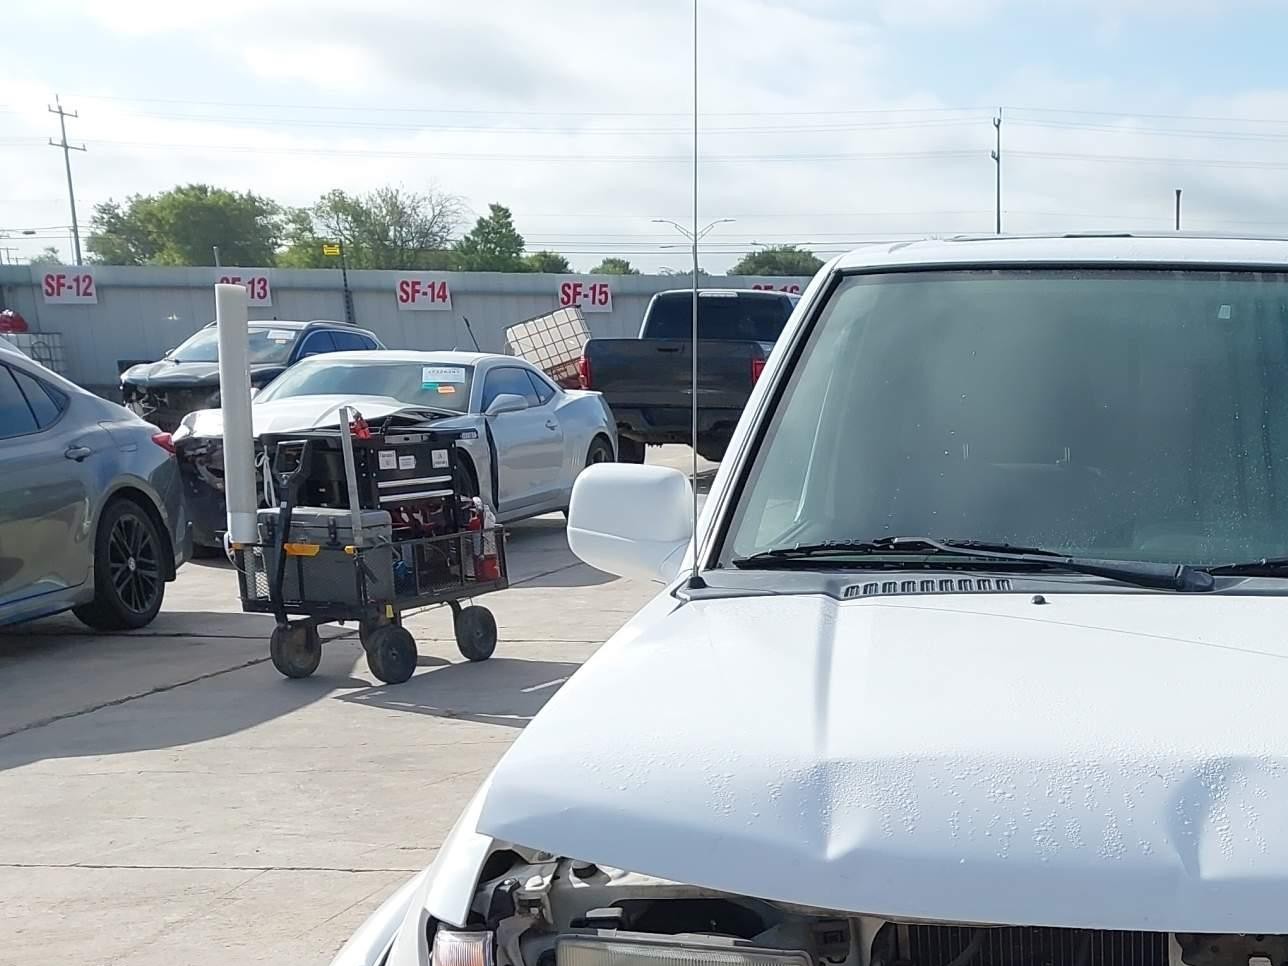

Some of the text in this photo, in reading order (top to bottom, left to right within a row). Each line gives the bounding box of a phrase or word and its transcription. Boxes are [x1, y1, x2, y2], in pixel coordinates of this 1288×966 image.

[44, 274, 93, 297] SF-12
[399, 280, 447, 303] SF-14
[560, 282, 609, 306] SF-15
